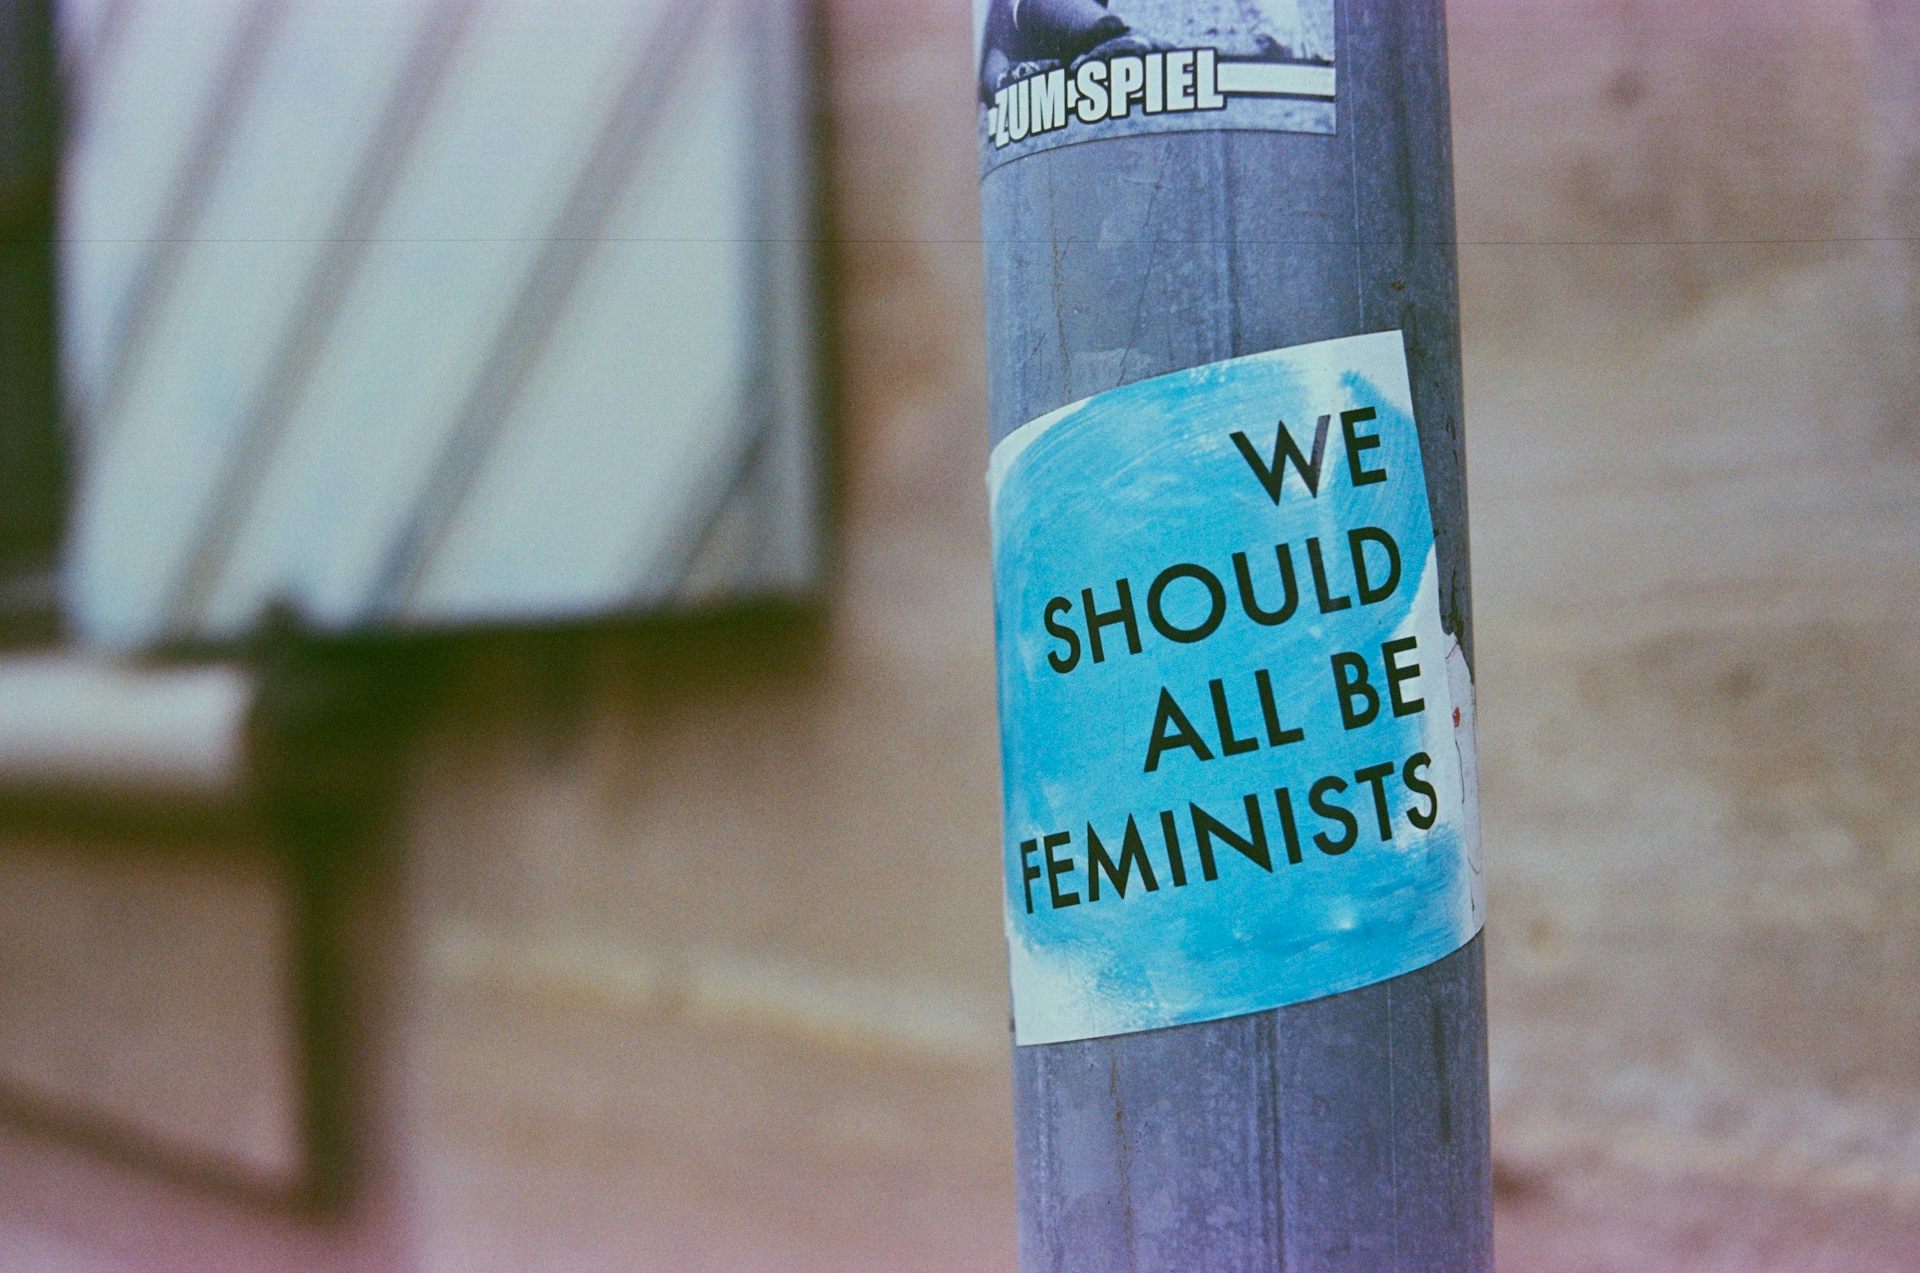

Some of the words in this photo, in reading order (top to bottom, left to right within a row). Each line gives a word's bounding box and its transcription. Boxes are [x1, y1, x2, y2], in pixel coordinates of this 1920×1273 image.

[1229, 406, 1387, 507] WE
[1043, 525, 1402, 674] SHOULD
[1143, 668, 1305, 773] ALL
[1330, 635, 1426, 731] BE
[1019, 751, 1438, 915] FEMINISTS
